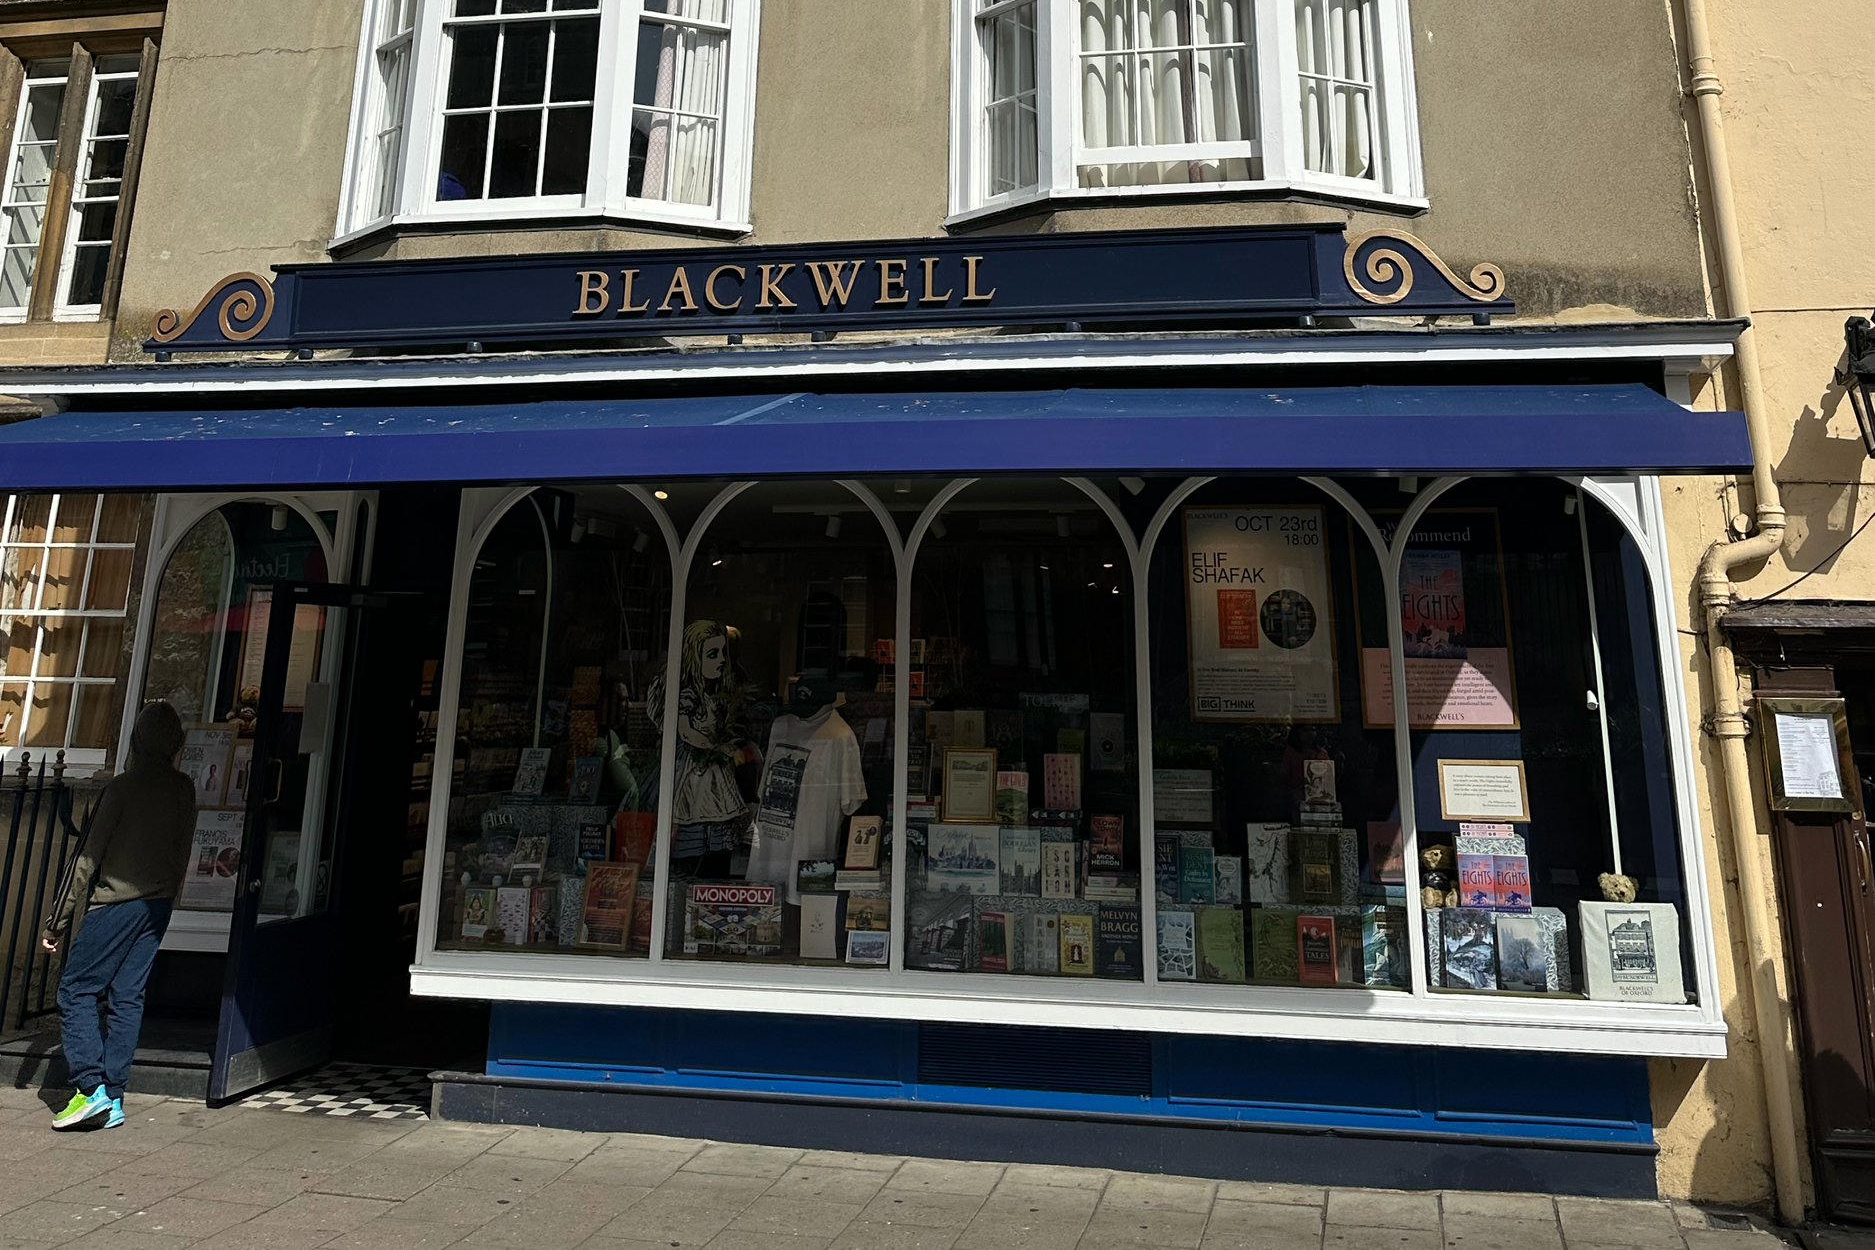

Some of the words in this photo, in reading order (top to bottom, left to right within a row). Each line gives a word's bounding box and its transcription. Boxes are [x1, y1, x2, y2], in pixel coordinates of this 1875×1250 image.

[572, 256, 997, 314] BLACKWELL
[1235, 516, 1273, 531] OCT
[1280, 516, 1317, 531] 23rd
[1285, 534, 1318, 545] 18:00
[1379, 526, 1472, 542] Reommend
[1192, 552, 1228, 568] ELIF
[1192, 568, 1265, 584] SHAFAK
[1420, 576, 1438, 590] THE
[1402, 595, 1460, 620] EIGHTS
[1201, 700, 1218, 708] BIG
[1223, 700, 1255, 709] THINK
[1417, 713, 1465, 721] BLACKWELL'S
[217, 813, 237, 821] SEPT
[194, 837, 234, 845] FUKUYAMA
[1185, 852, 1207, 860] SUSIE
[1186, 861, 1208, 869] DENT
[1471, 861, 1480, 870] THE
[1506, 862, 1515, 871] THE
[1462, 871, 1492, 885] EIGHTS
[1497, 871, 1527, 886] EIGHTS
[696, 888, 772, 903] MONOPOLY
[1100, 910, 1138, 920] MELVYN
[1101, 922, 1139, 933] BRAGG
[1306, 951, 1330, 959] TALES
